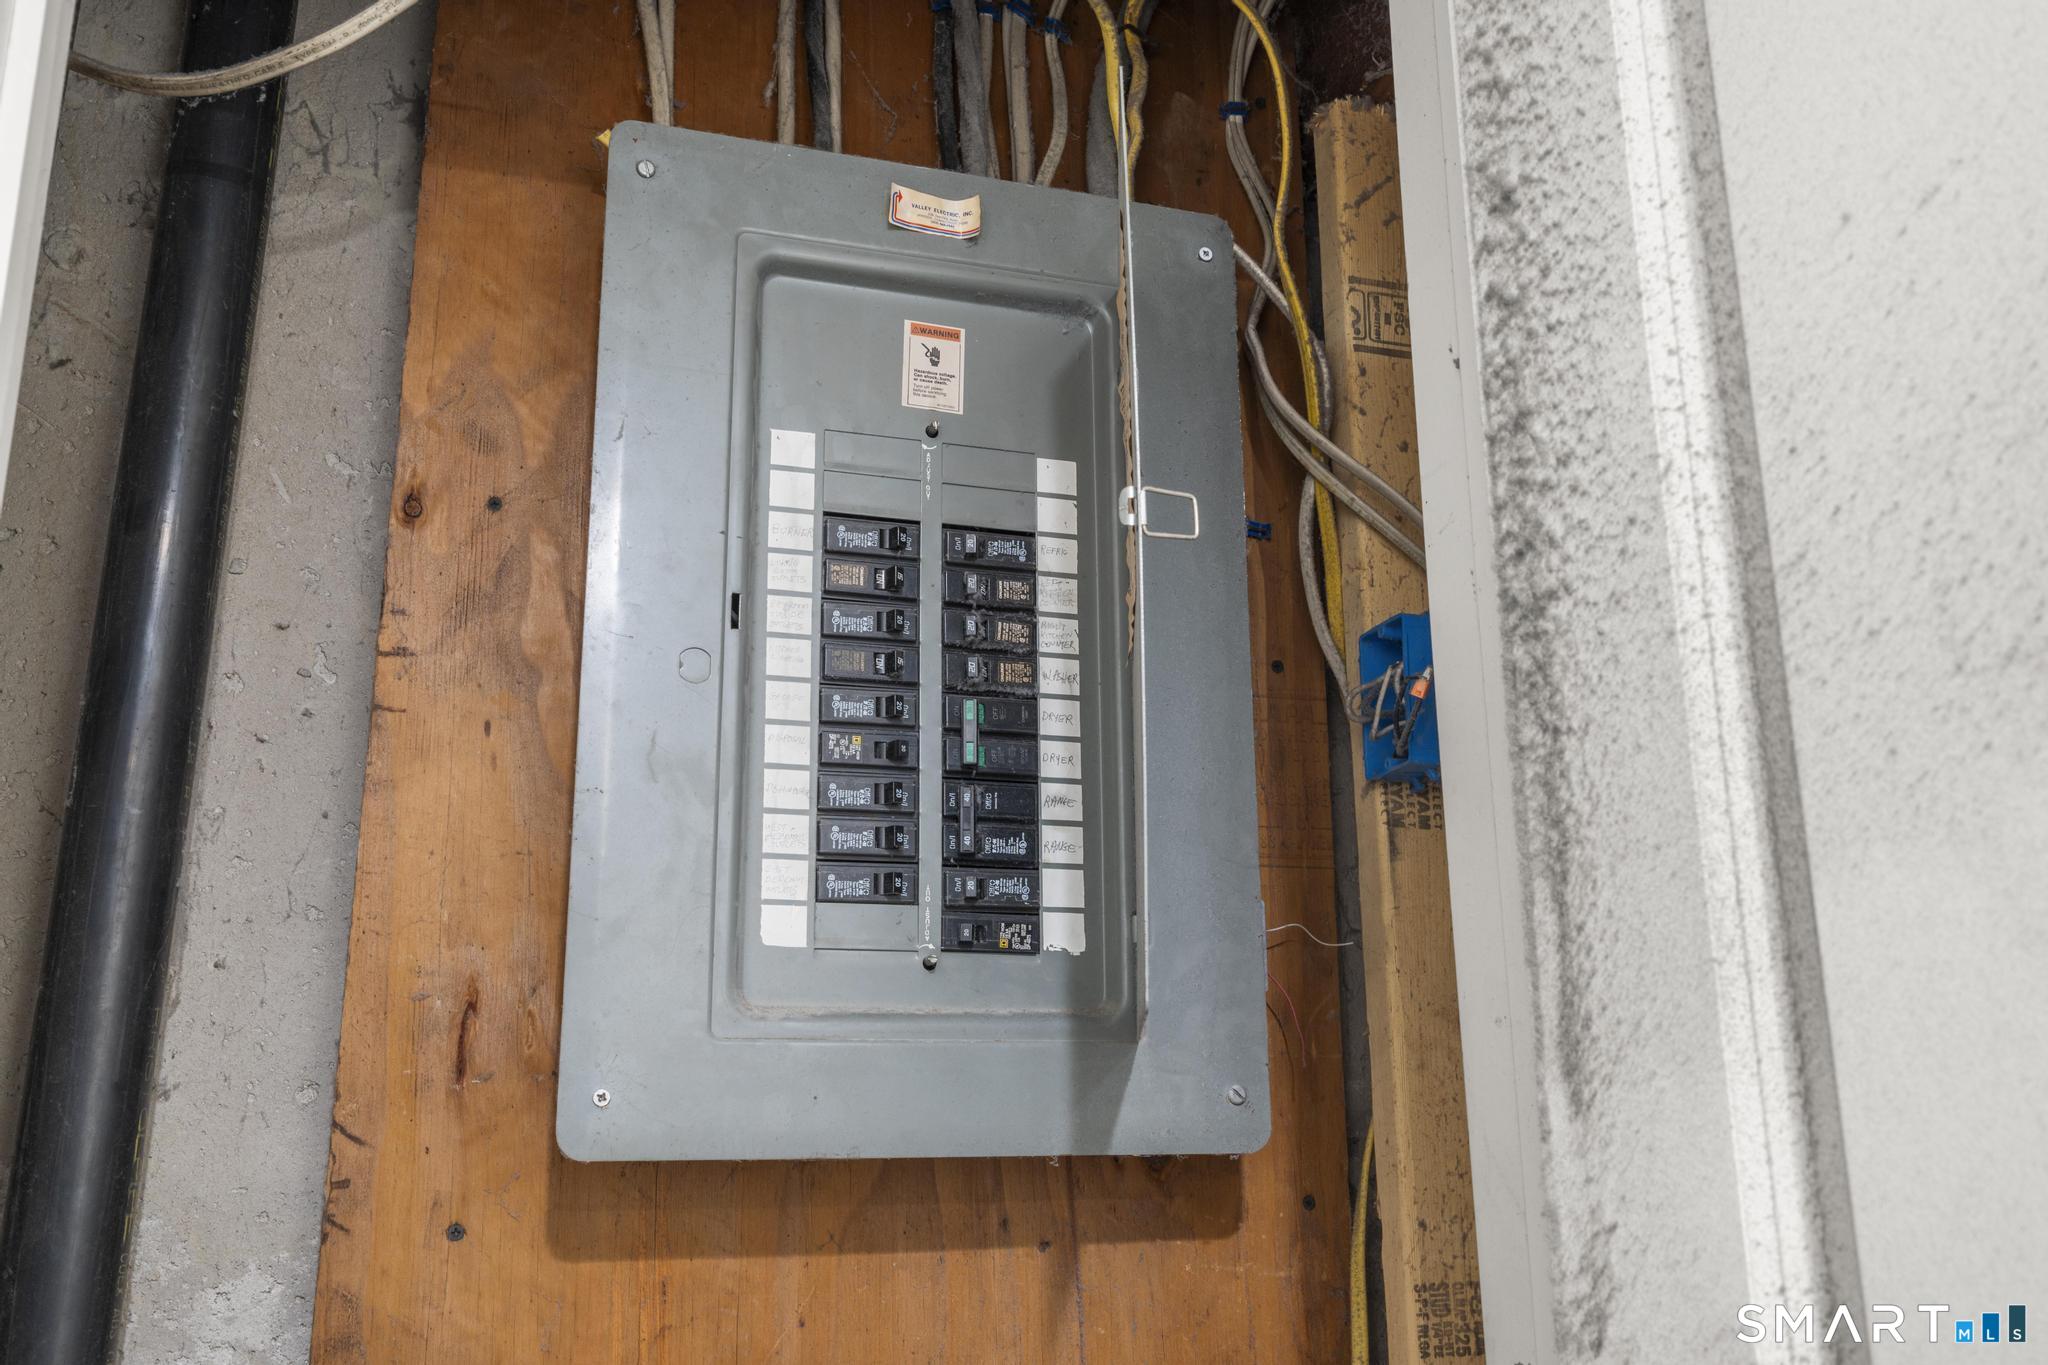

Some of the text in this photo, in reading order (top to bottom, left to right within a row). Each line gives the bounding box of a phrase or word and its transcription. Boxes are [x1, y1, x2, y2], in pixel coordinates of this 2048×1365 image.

[911, 203, 931, 212] VALLEY
[919, 327, 960, 339] WARNING
[967, 538, 974, 548] 20
[967, 619, 974, 631] 20
[968, 662, 976, 673] 20
[896, 701, 902, 710] 20
[1042, 710, 1074, 726] DRYER
[1042, 753, 1075, 767] DRYER
[895, 788, 902, 798] 20
[1432, 784, 1442, 830] ELECT
[896, 832, 903, 842] 20
[963, 836, 971, 845] 40
[967, 880, 974, 890] 20
